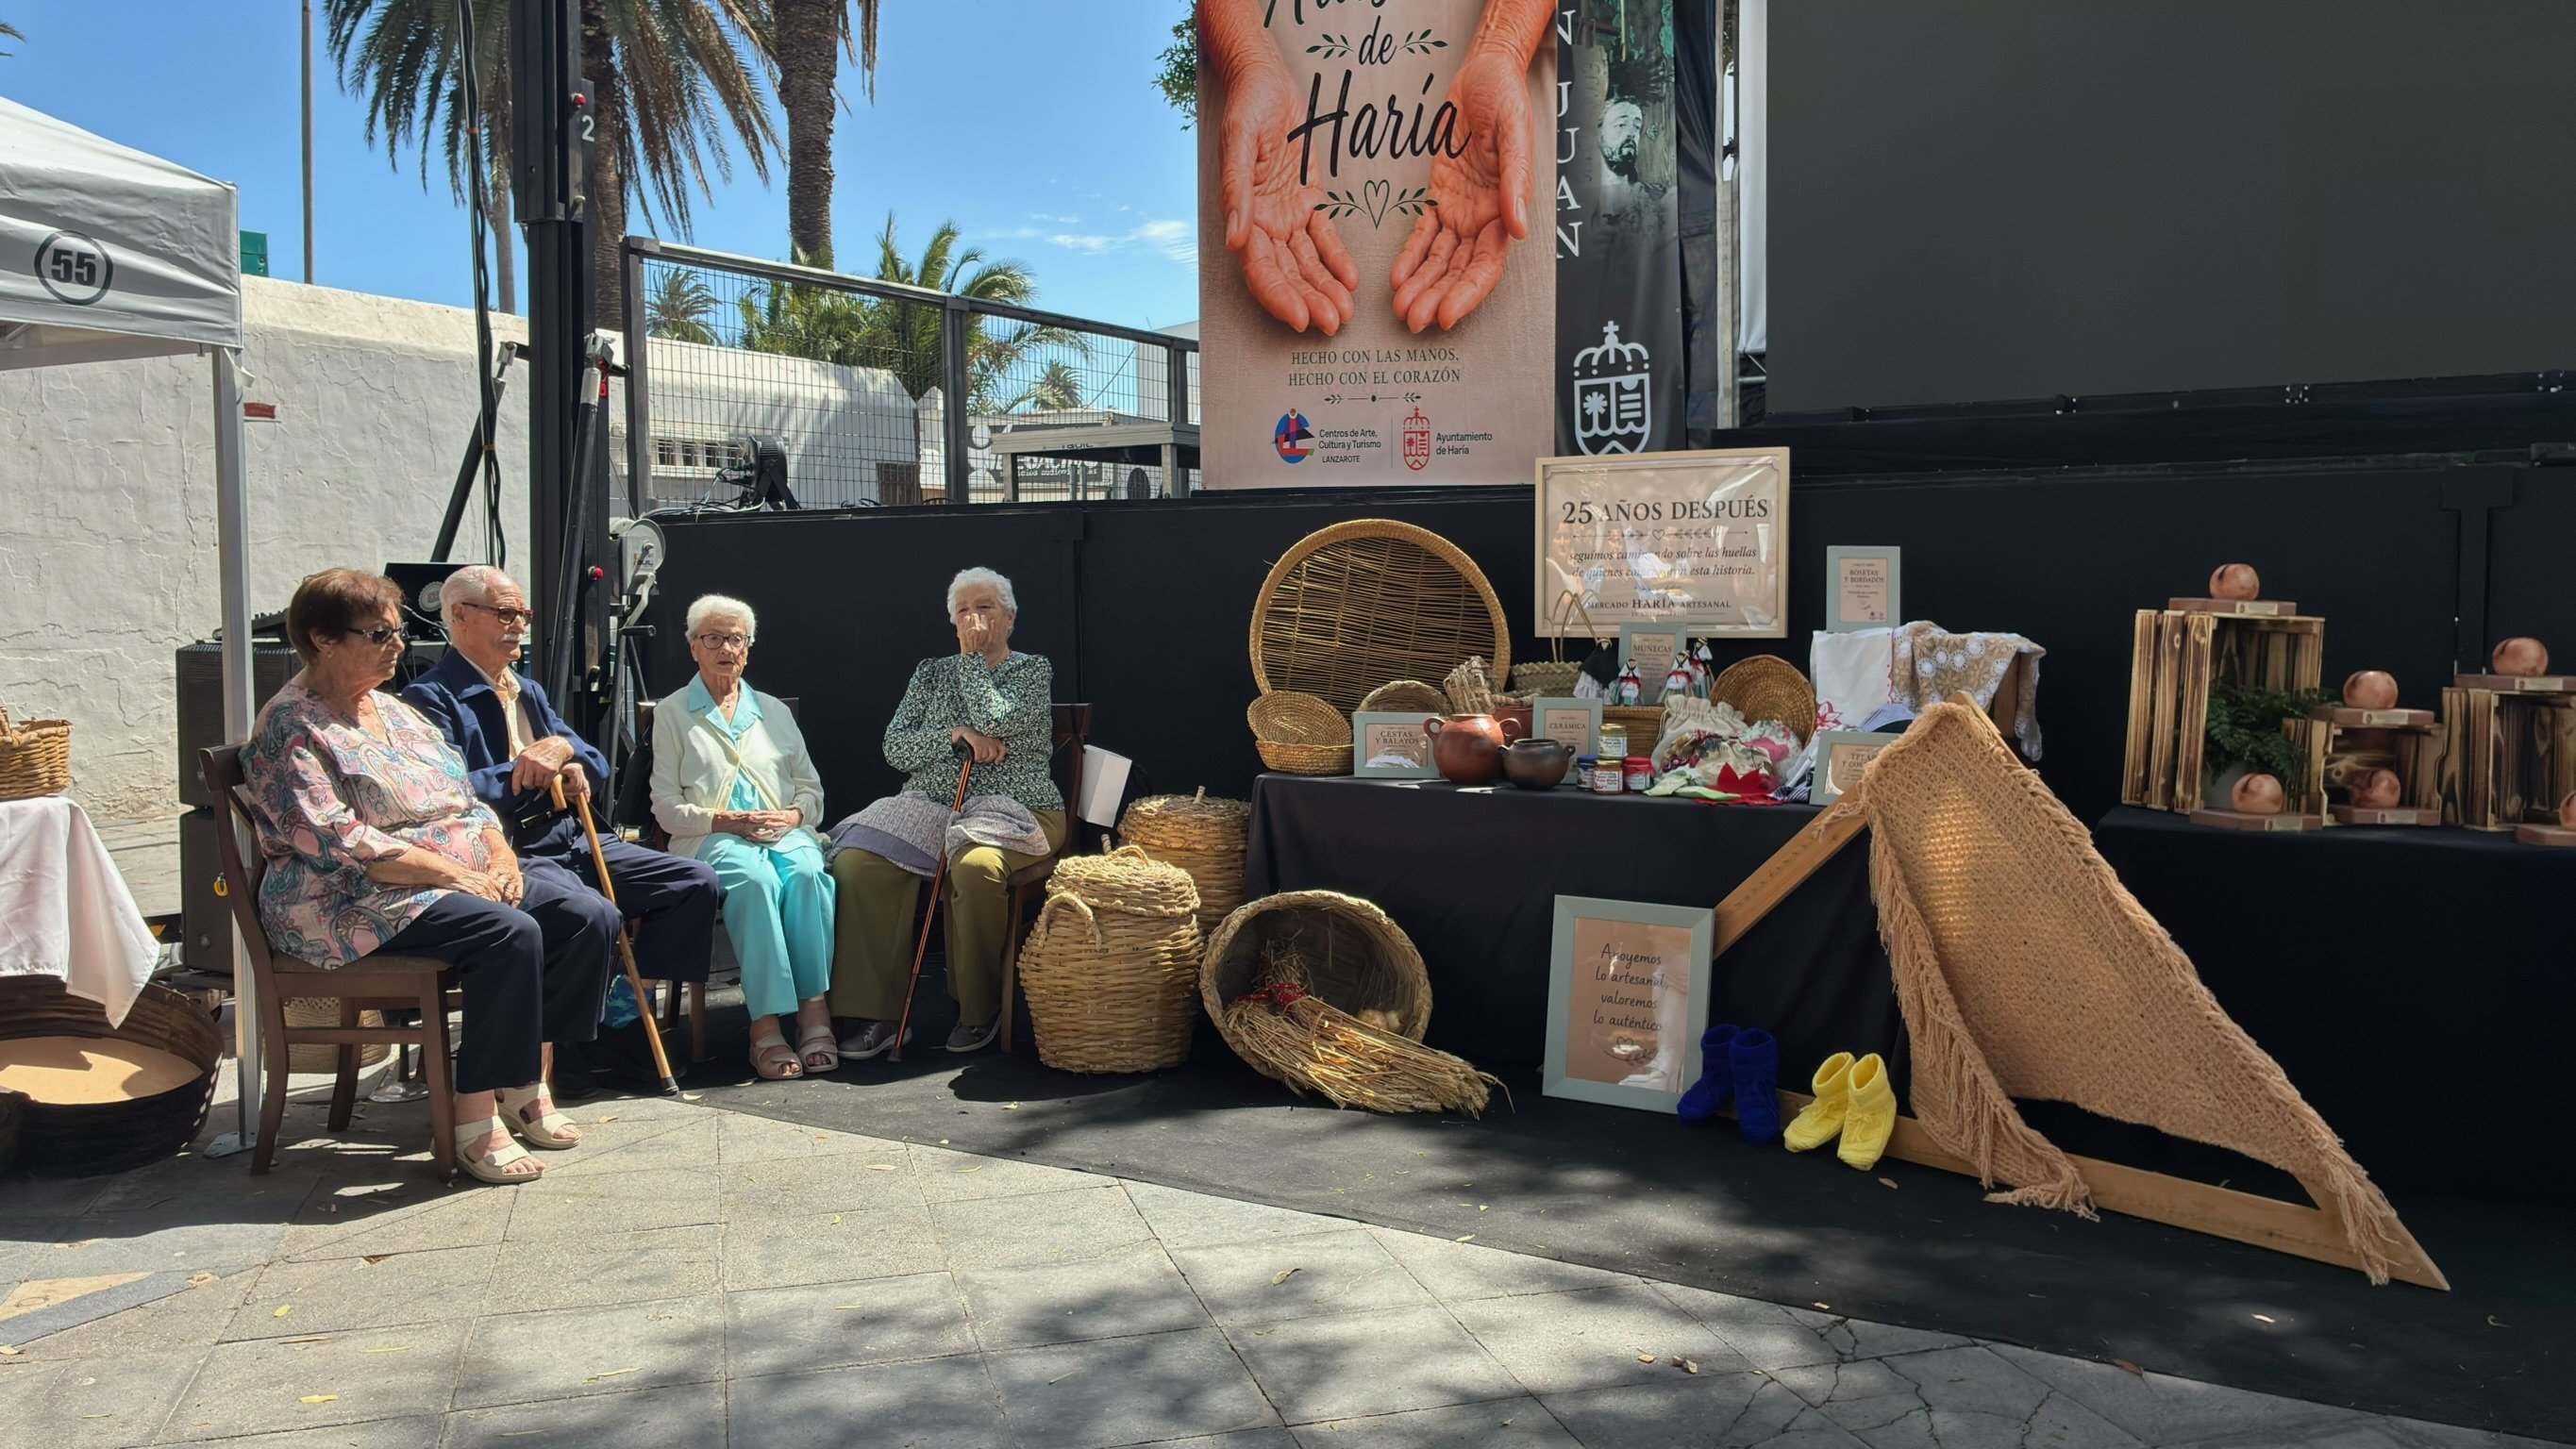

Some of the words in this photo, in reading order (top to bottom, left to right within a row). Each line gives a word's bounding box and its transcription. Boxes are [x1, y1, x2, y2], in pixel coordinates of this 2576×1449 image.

[1359, 15, 1397, 64] de
[581, 114, 595, 142] 2
[1287, 69, 1472, 186] Haría
[51, 248, 96, 286] 55
[1291, 351, 1338, 365] HECHO
[1342, 350, 1371, 364] CON
[1376, 349, 1402, 363] LAS
[1406, 348, 1460, 362] MANOS,
[1289, 373, 1334, 386] HECHO
[1339, 372, 1368, 385] CON
[1373, 371, 1389, 384] EL
[1394, 366, 1462, 383] CORAZÓN
[1319, 428, 1348, 438] Centros
[1348, 428, 1360, 438] de
[1360, 428, 1379, 439] Arte,
[1435, 432, 1493, 442] Ayuntamiento
[1318, 440, 1347, 449] Cultura
[1346, 441, 1352, 451] y
[1351, 440, 1381, 449] Turismo
[1435, 446, 1447, 455] de
[1447, 444, 1470, 455] Haría
[1562, 501, 1593, 525] 25
[1598, 499, 1663, 522] AÑOS
[1671, 494, 1769, 520] DESPUÉS
[1569, 549, 1614, 563] seguimos
[1676, 546, 1702, 559] sobre
[1704, 546, 1719, 558] las
[1721, 545, 1757, 558] huellas
[1689, 566, 1710, 576] esta
[1713, 564, 1755, 576] historia.
[1588, 601, 1629, 609] MERCADO
[1631, 597, 1676, 609] HARÍA
[1681, 600, 1731, 608] ARTESANAL
[1633, 643, 1672, 653] MUÑECAS
[1595, 965, 1606, 981] lo
[1600, 990, 1658, 1009] valoremos
[1593, 1009, 1604, 1024] lo
[1609, 1014, 1662, 1031] auténtico
